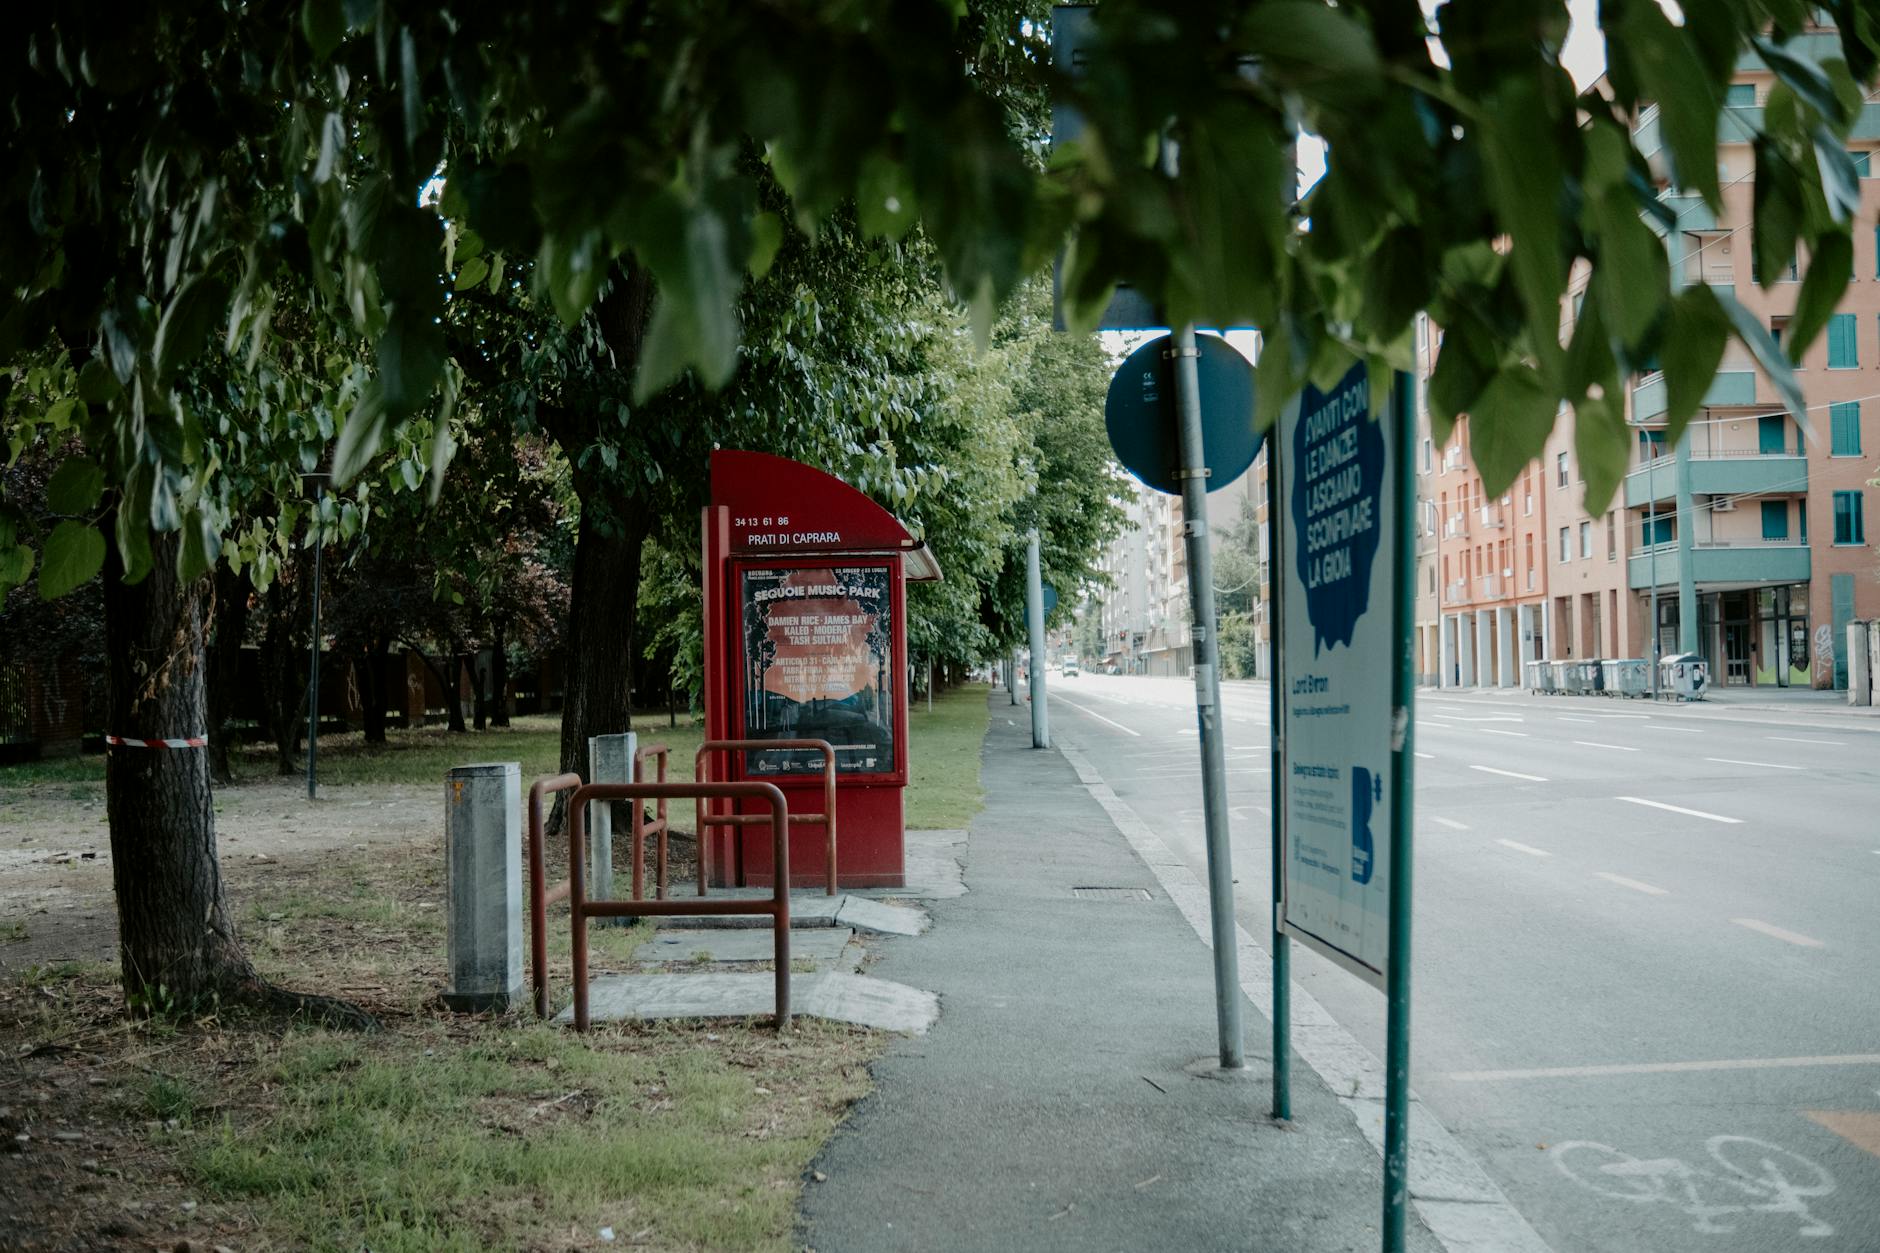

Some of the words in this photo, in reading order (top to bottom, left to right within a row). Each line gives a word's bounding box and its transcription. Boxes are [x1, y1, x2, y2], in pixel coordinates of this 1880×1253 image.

[1304, 397, 1341, 448] AVANTI
[1342, 377, 1368, 422] CON
[1304, 449, 1319, 483] LE
[1305, 464, 1362, 518] LASCIAMO
[735, 518, 746, 527] 34
[748, 517, 758, 527] 13
[762, 517, 772, 526] 61
[778, 516, 789, 526] 86
[1307, 496, 1373, 553] SCONFINARE
[748, 534, 776, 545] PRATI
[779, 534, 790, 544] DI
[792, 532, 841, 544] CAPRARA
[1308, 557, 1323, 589] LA
[1323, 546, 1352, 584] GIOIA
[754, 586, 805, 602] SEQUOIE
[807, 585, 847, 596] MUSIC
[849, 586, 881, 598] PARK
[768, 616, 799, 626] DAMIEN
[801, 616, 820, 625] RICE
[824, 615, 850, 624] JAMES
[852, 615, 868, 624] BAY
[784, 626, 810, 636] KALEO
[814, 625, 853, 635] MODERAT
[790, 636, 810, 646] TASH
